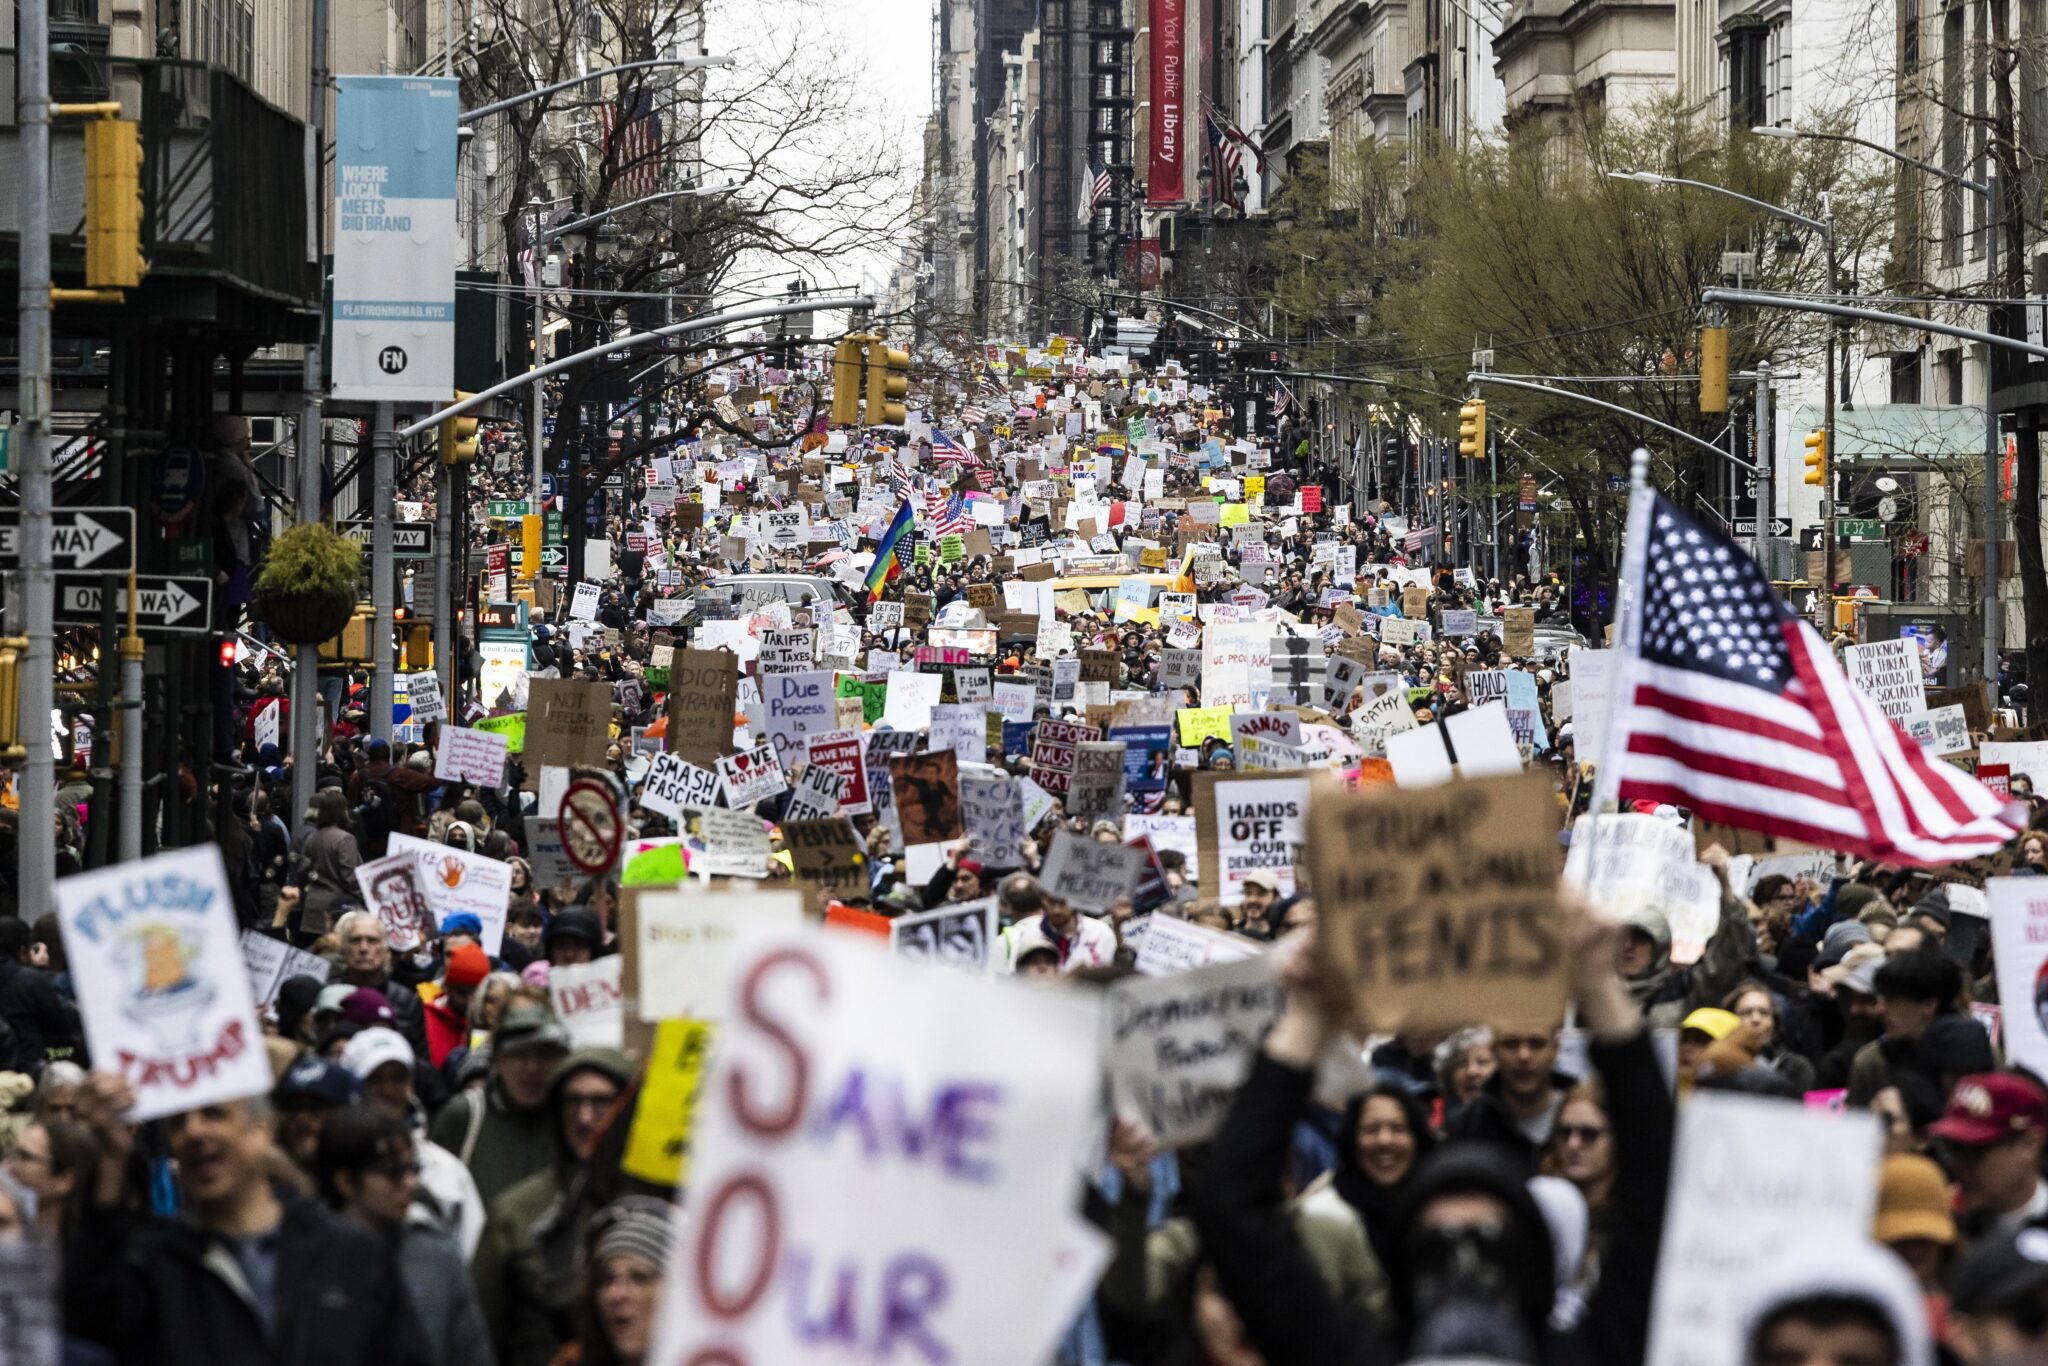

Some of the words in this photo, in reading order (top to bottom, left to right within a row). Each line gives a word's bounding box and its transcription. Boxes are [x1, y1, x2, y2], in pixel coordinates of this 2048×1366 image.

[1164, 17, 1179, 48] York
[1164, 55, 1178, 97] Public
[1160, 103, 1178, 163] Library
[342, 165, 389, 182] WHERE
[342, 182, 383, 198] LOCAL
[342, 200, 386, 215] MEETS
[341, 215, 364, 231] BIG
[366, 216, 412, 232] BRAND
[382, 349, 404, 369] FN
[1073, 464, 1084, 472] NO
[1038, 484, 1055, 492] NEVER
[1040, 490, 1054, 498] EVER
[495, 503, 503, 514] W
[506, 503, 516, 514] 32
[1022, 522, 1044, 532] LIBERTY
[1740, 524, 1756, 532] ONE
[1844, 523, 1849, 534] E
[1852, 522, 1864, 534] 32
[52, 529, 101, 552] WAY
[350, 530, 374, 544] ONE
[76, 590, 108, 608] ON
[140, 594, 186, 612] WAY
[578, 589, 597, 598] OFF!
[876, 604, 888, 612] GET
[1174, 618, 1198, 636] HANDS
[1174, 628, 1192, 640] OFF
[762, 629, 809, 646] TARIFFS
[836, 641, 850, 652] 47
[1856, 645, 1876, 660] YOU
[1876, 640, 1905, 656] KNOW
[760, 650, 776, 661] ARE
[778, 648, 810, 662] TAXES
[1167, 653, 1185, 661] PICK
[1082, 664, 1112, 678] NAZI
[1858, 659, 1874, 675] THE
[1878, 655, 1910, 672] THREAT
[414, 676, 428, 686] THIS
[782, 678, 820, 698] Due
[844, 681, 864, 696] DO
[960, 676, 988, 688] F-ELON
[1472, 672, 1508, 697] HAND
[1856, 676, 1865, 689] IS
[1866, 672, 1905, 690] SERIOUS
[409, 686, 438, 697] MACHINE
[416, 694, 434, 704] KILLS
[1877, 684, 1920, 702] SOCIALLY
[413, 702, 442, 714] FASCISTS
[554, 692, 586, 708] NOT
[771, 698, 827, 717] Process
[550, 711, 596, 724] FEELING
[934, 710, 956, 721] ELON
[1880, 702, 1912, 718] XIOUS
[794, 720, 806, 732] Is
[1041, 722, 1098, 742] DEPORT
[1238, 716, 1290, 736] HANDS
[774, 732, 805, 752] Ove
[810, 730, 854, 744] PSC-CUNY
[869, 736, 912, 750] DEAR
[724, 747, 772, 776] LVE
[812, 749, 838, 762] SAVE
[839, 746, 859, 757] THE
[866, 752, 890, 768] CAN
[1036, 746, 1073, 766] MUS
[730, 770, 753, 786] NOT
[754, 760, 779, 778] HATE
[822, 760, 856, 770] OCIAL
[655, 756, 718, 796] SMASH
[801, 764, 845, 800] FUCK
[1980, 776, 2008, 785] HANDS
[964, 801, 1022, 820] TRUMP
[1082, 800, 1108, 812] JOB
[1228, 802, 1298, 820] HANDS
[1131, 820, 1178, 830] HANDS
[1231, 820, 1282, 840] OFF
[1250, 841, 1286, 855] OUR
[1228, 854, 1298, 870] DEMOCRA
[73, 873, 216, 944] FLUSH
[116, 1018, 246, 1089] TRUMP
[727, 945, 1008, 1183] SAVE
[693, 1171, 953, 1366] OUR
